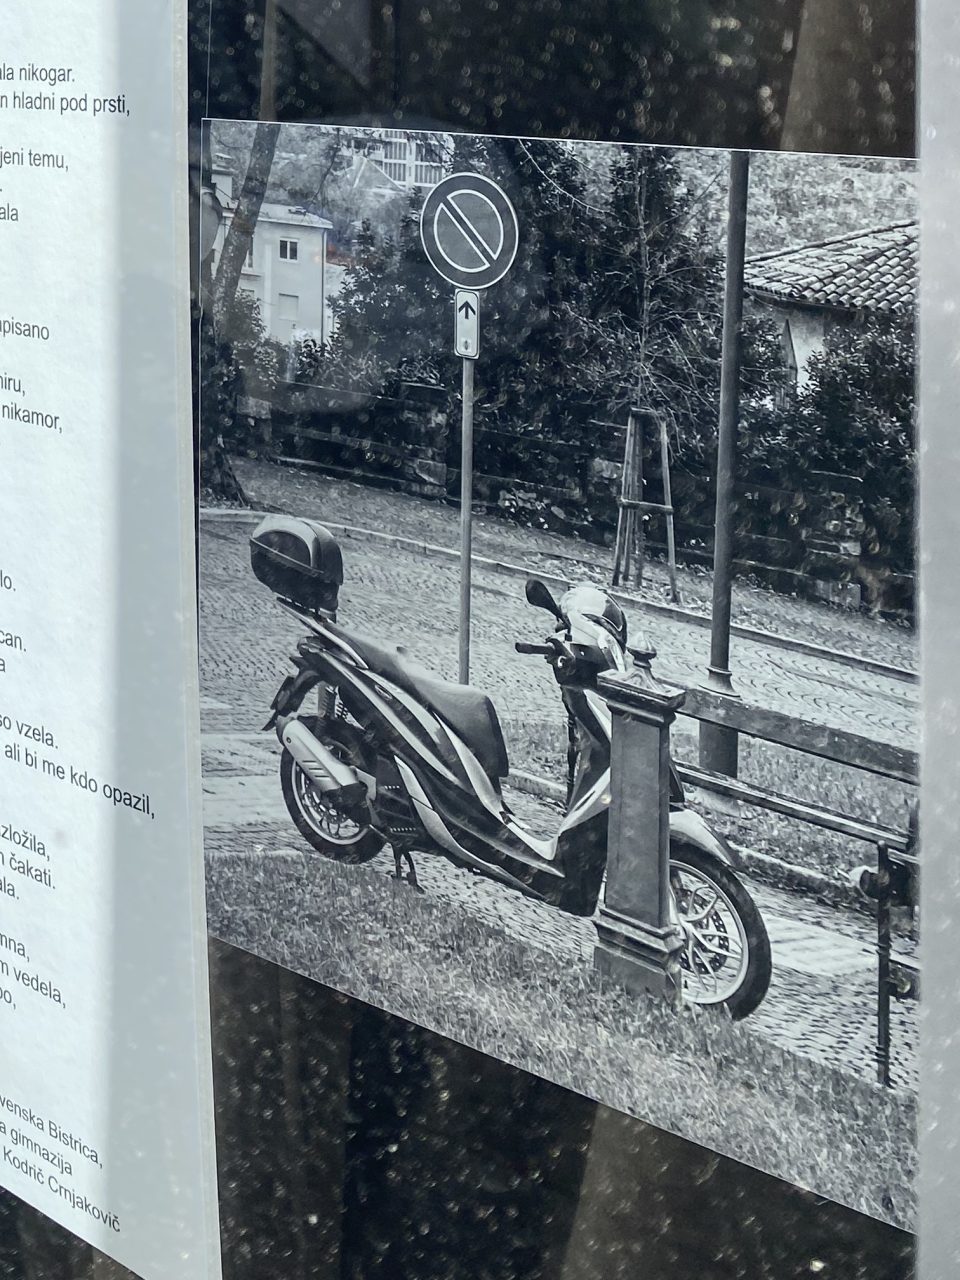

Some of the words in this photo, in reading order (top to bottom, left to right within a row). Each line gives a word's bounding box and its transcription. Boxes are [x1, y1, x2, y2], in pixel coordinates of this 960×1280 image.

[18, 62, 76, 87] nikogar.
[12, 89, 56, 111] hladni
[59, 92, 88, 116] pod
[92, 93, 130, 117] prsti,
[27, 148, 69, 173] temu,
[14, 719, 59, 750] vzela.
[4, 741, 21, 763] ali
[24, 746, 38, 770] bi
[41, 758, 66, 781] me
[69, 764, 98, 794] kdo
[101, 783, 155, 820] opazil,
[8, 850, 56, 890] čakati.
[12, 965, 66, 1010] vedela,
[9, 1127, 73, 1177] gimnazija
[47, 1119, 103, 1170] Bistrica,
[2, 1144, 45, 1186] Kodrič
[47, 1174, 121, 1233] Crnjakovič
